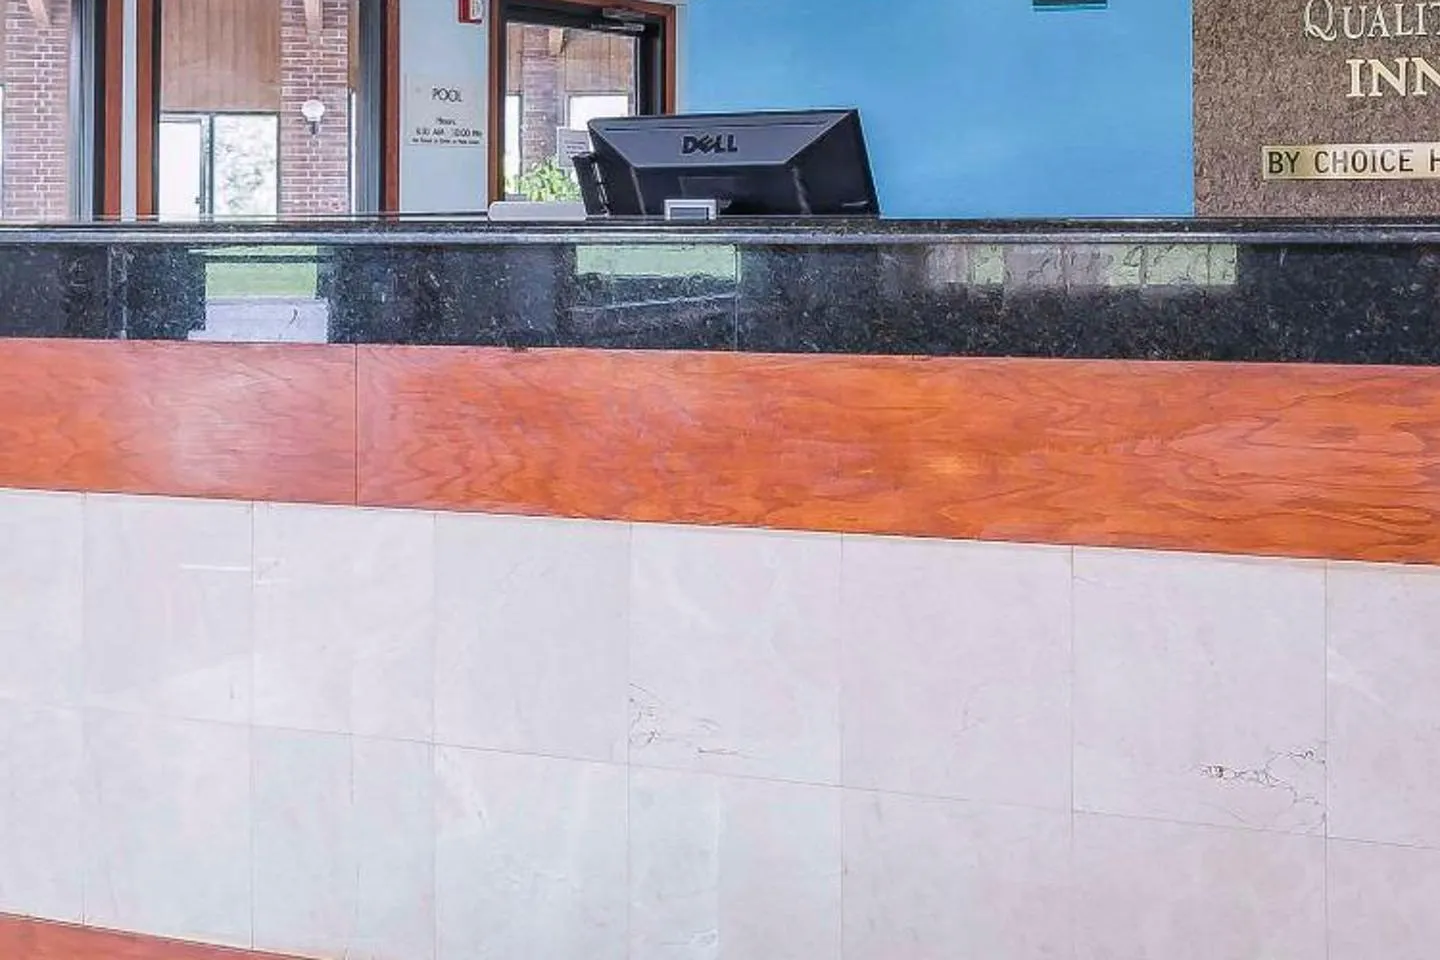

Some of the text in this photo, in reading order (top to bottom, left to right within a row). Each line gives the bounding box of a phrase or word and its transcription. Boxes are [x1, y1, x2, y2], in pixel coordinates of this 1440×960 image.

[432, 87, 462, 102] POOL
[682, 134, 738, 154] DELL
[1267, 150, 1300, 174] BY
[1314, 148, 1414, 173] CHOICE
